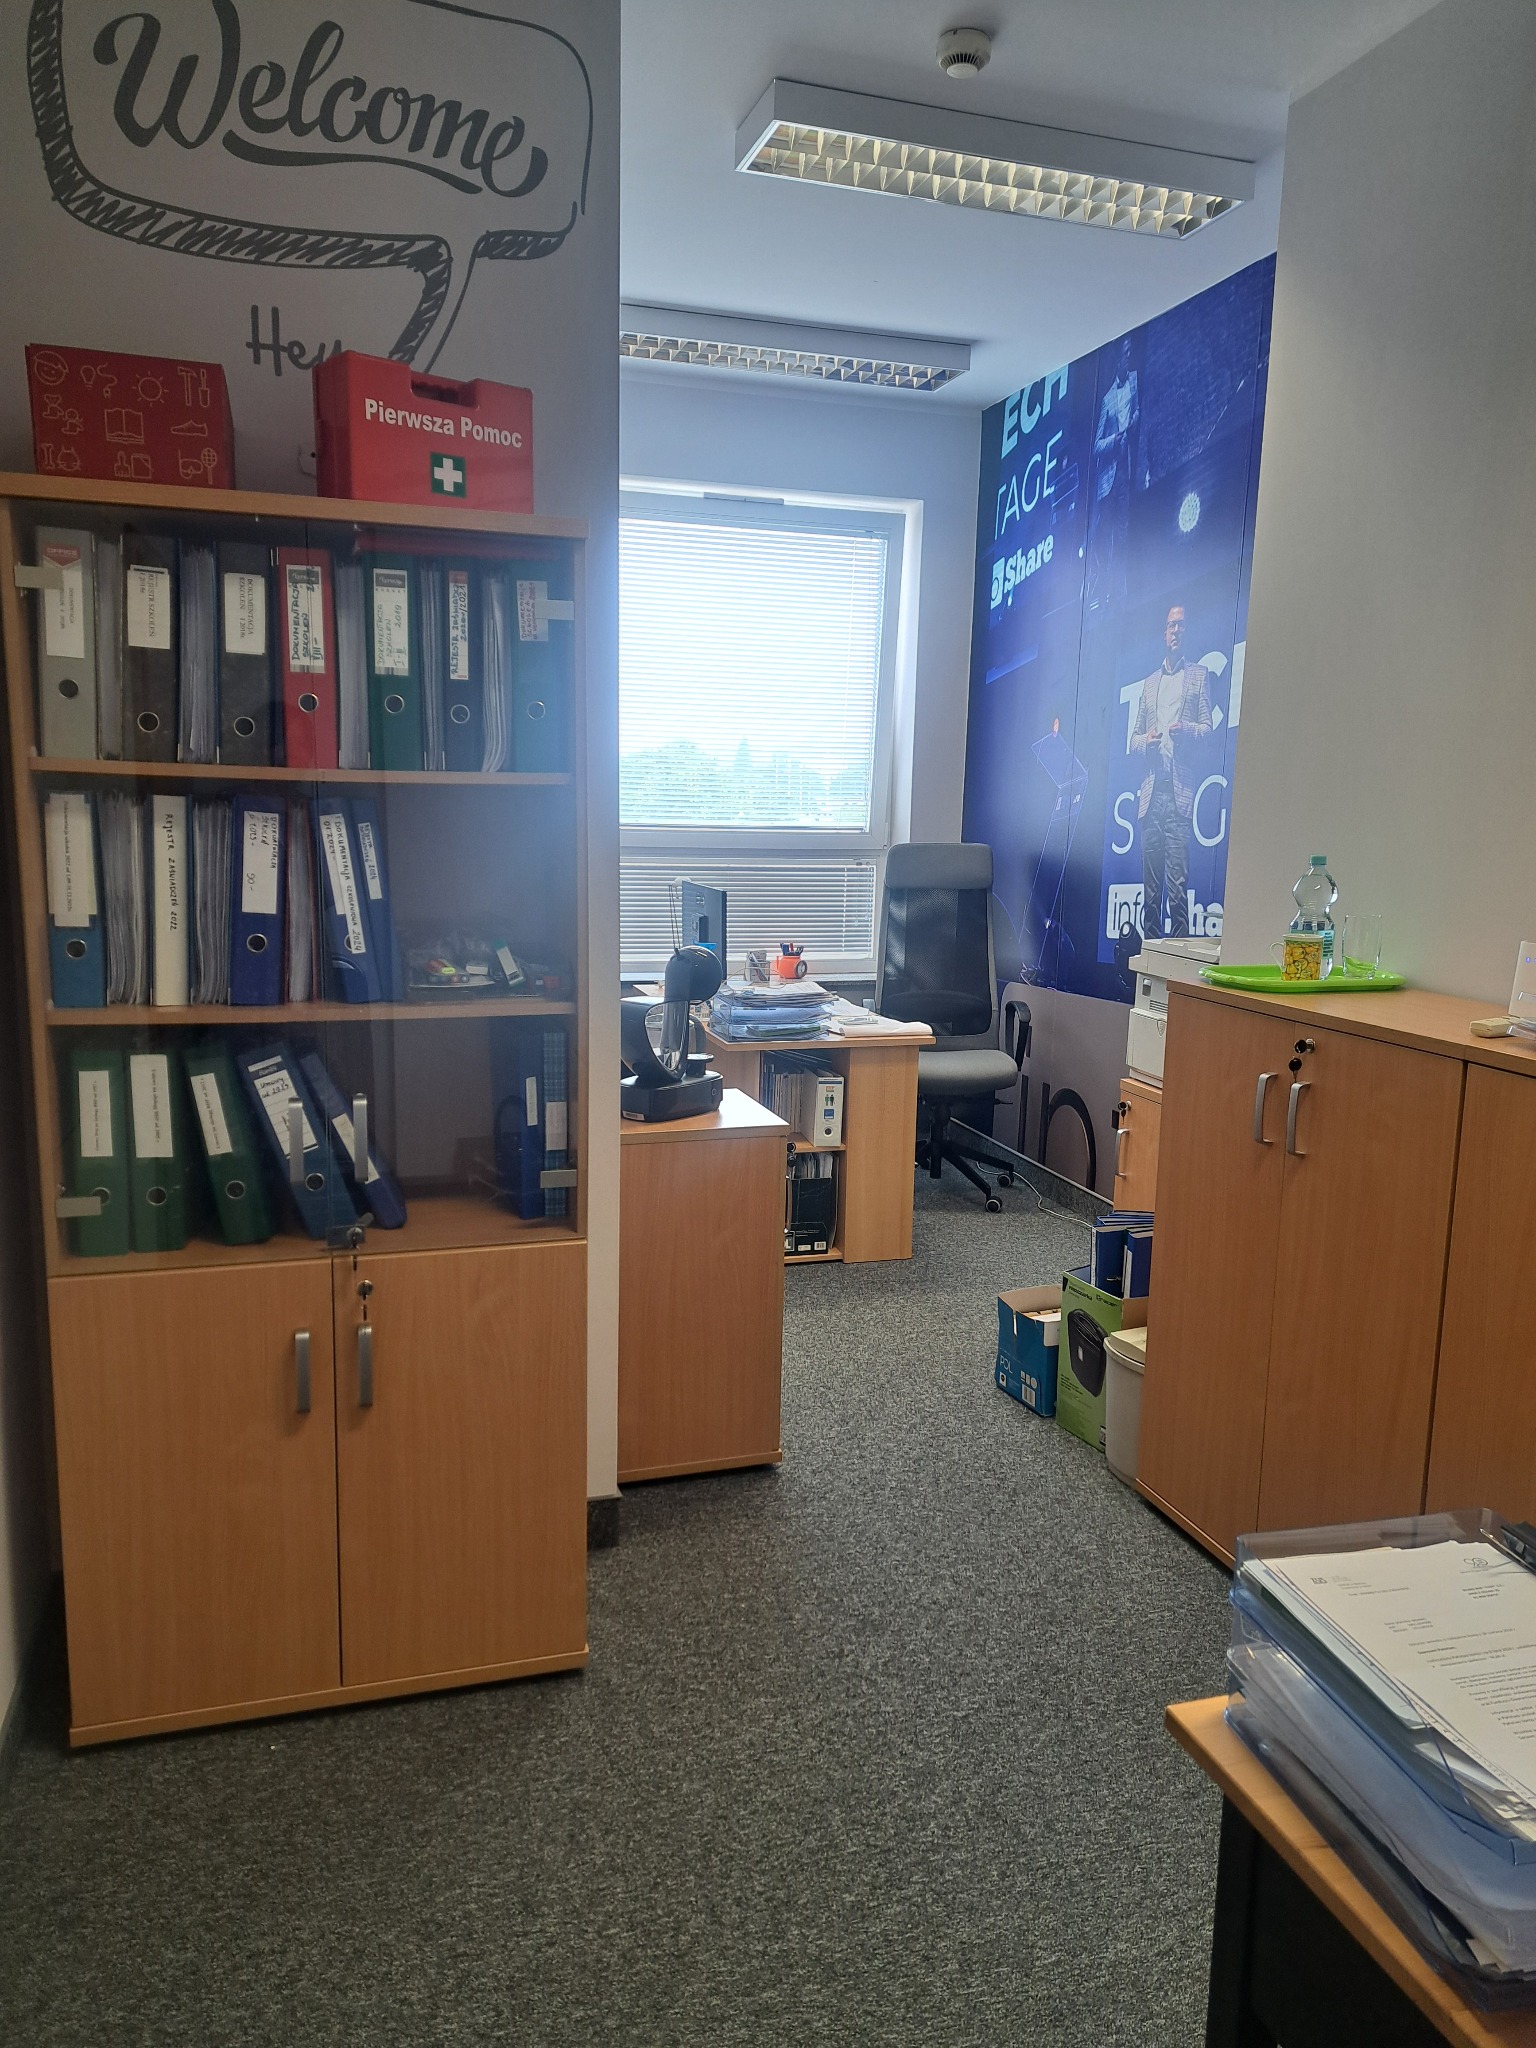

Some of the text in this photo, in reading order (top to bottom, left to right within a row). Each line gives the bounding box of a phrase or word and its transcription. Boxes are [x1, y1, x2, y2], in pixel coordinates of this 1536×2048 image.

[92, 0, 548, 198] Welcome
[364, 398, 524, 449] Pierwsza Pomoc
[291, 582, 300, 661] DOKUMENTACJA
[376, 604, 385, 666] DOKUMENTACJA
[163, 813, 179, 931] REJESTR ZAŚWIADCZEŃ 2022
[353, 929, 364, 951] 2024
